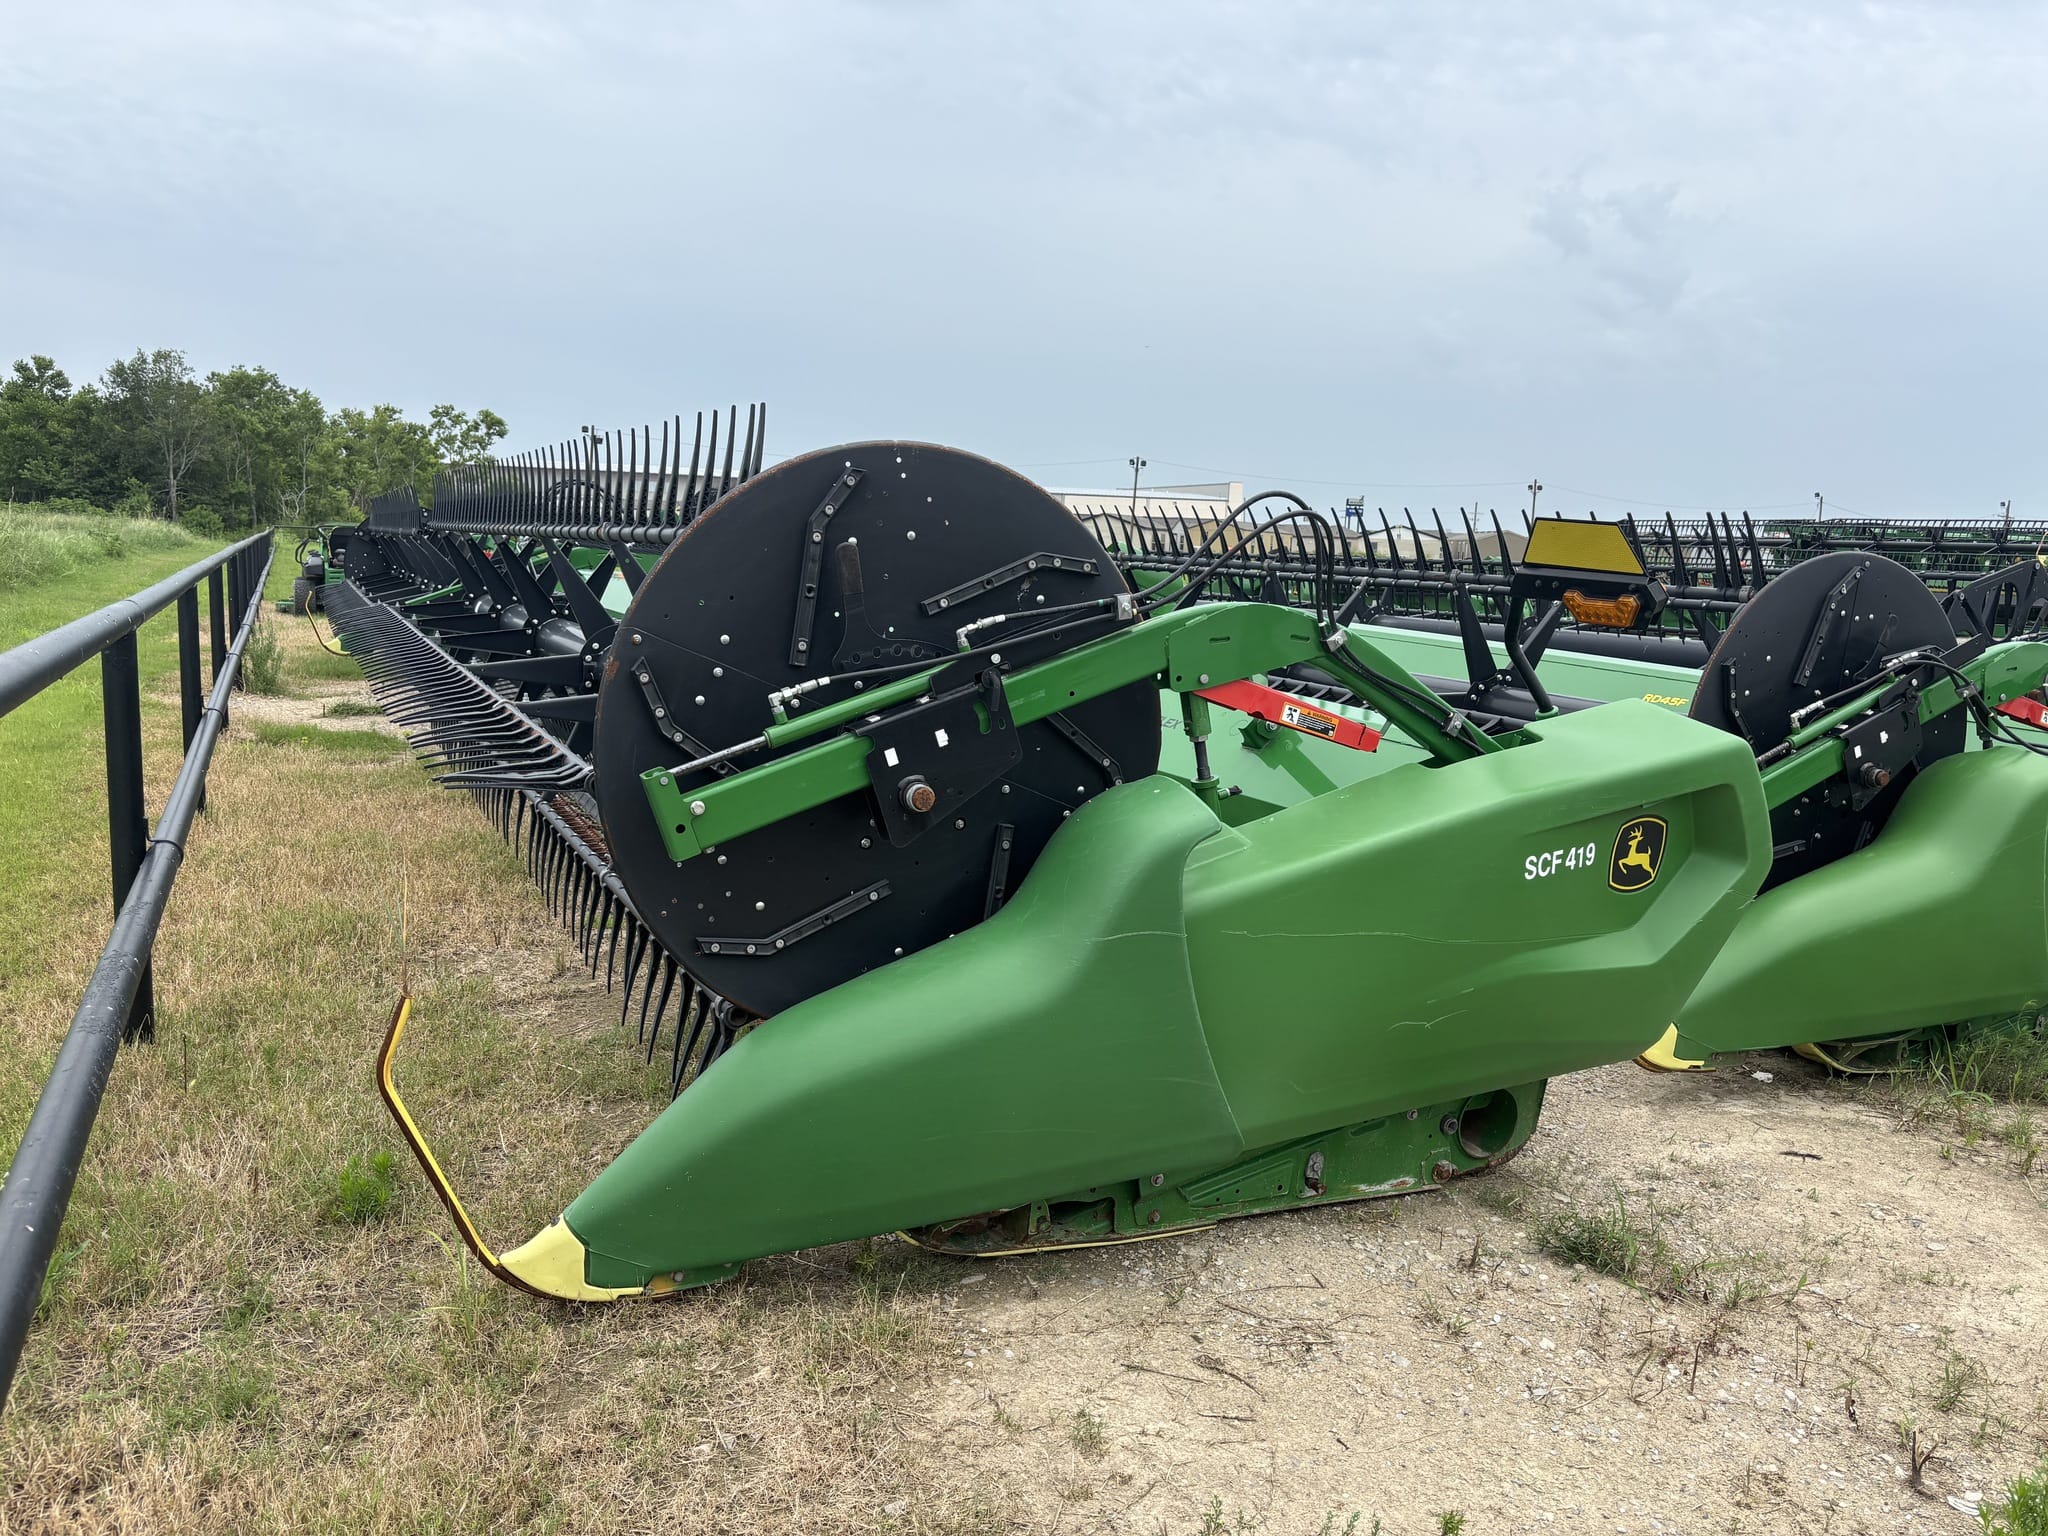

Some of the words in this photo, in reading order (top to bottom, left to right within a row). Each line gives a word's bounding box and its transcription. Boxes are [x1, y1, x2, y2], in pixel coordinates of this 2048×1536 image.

[1642, 693, 1689, 707] RD45F
[1524, 849, 1564, 880] SCF
[1565, 842, 1596, 870] 419
